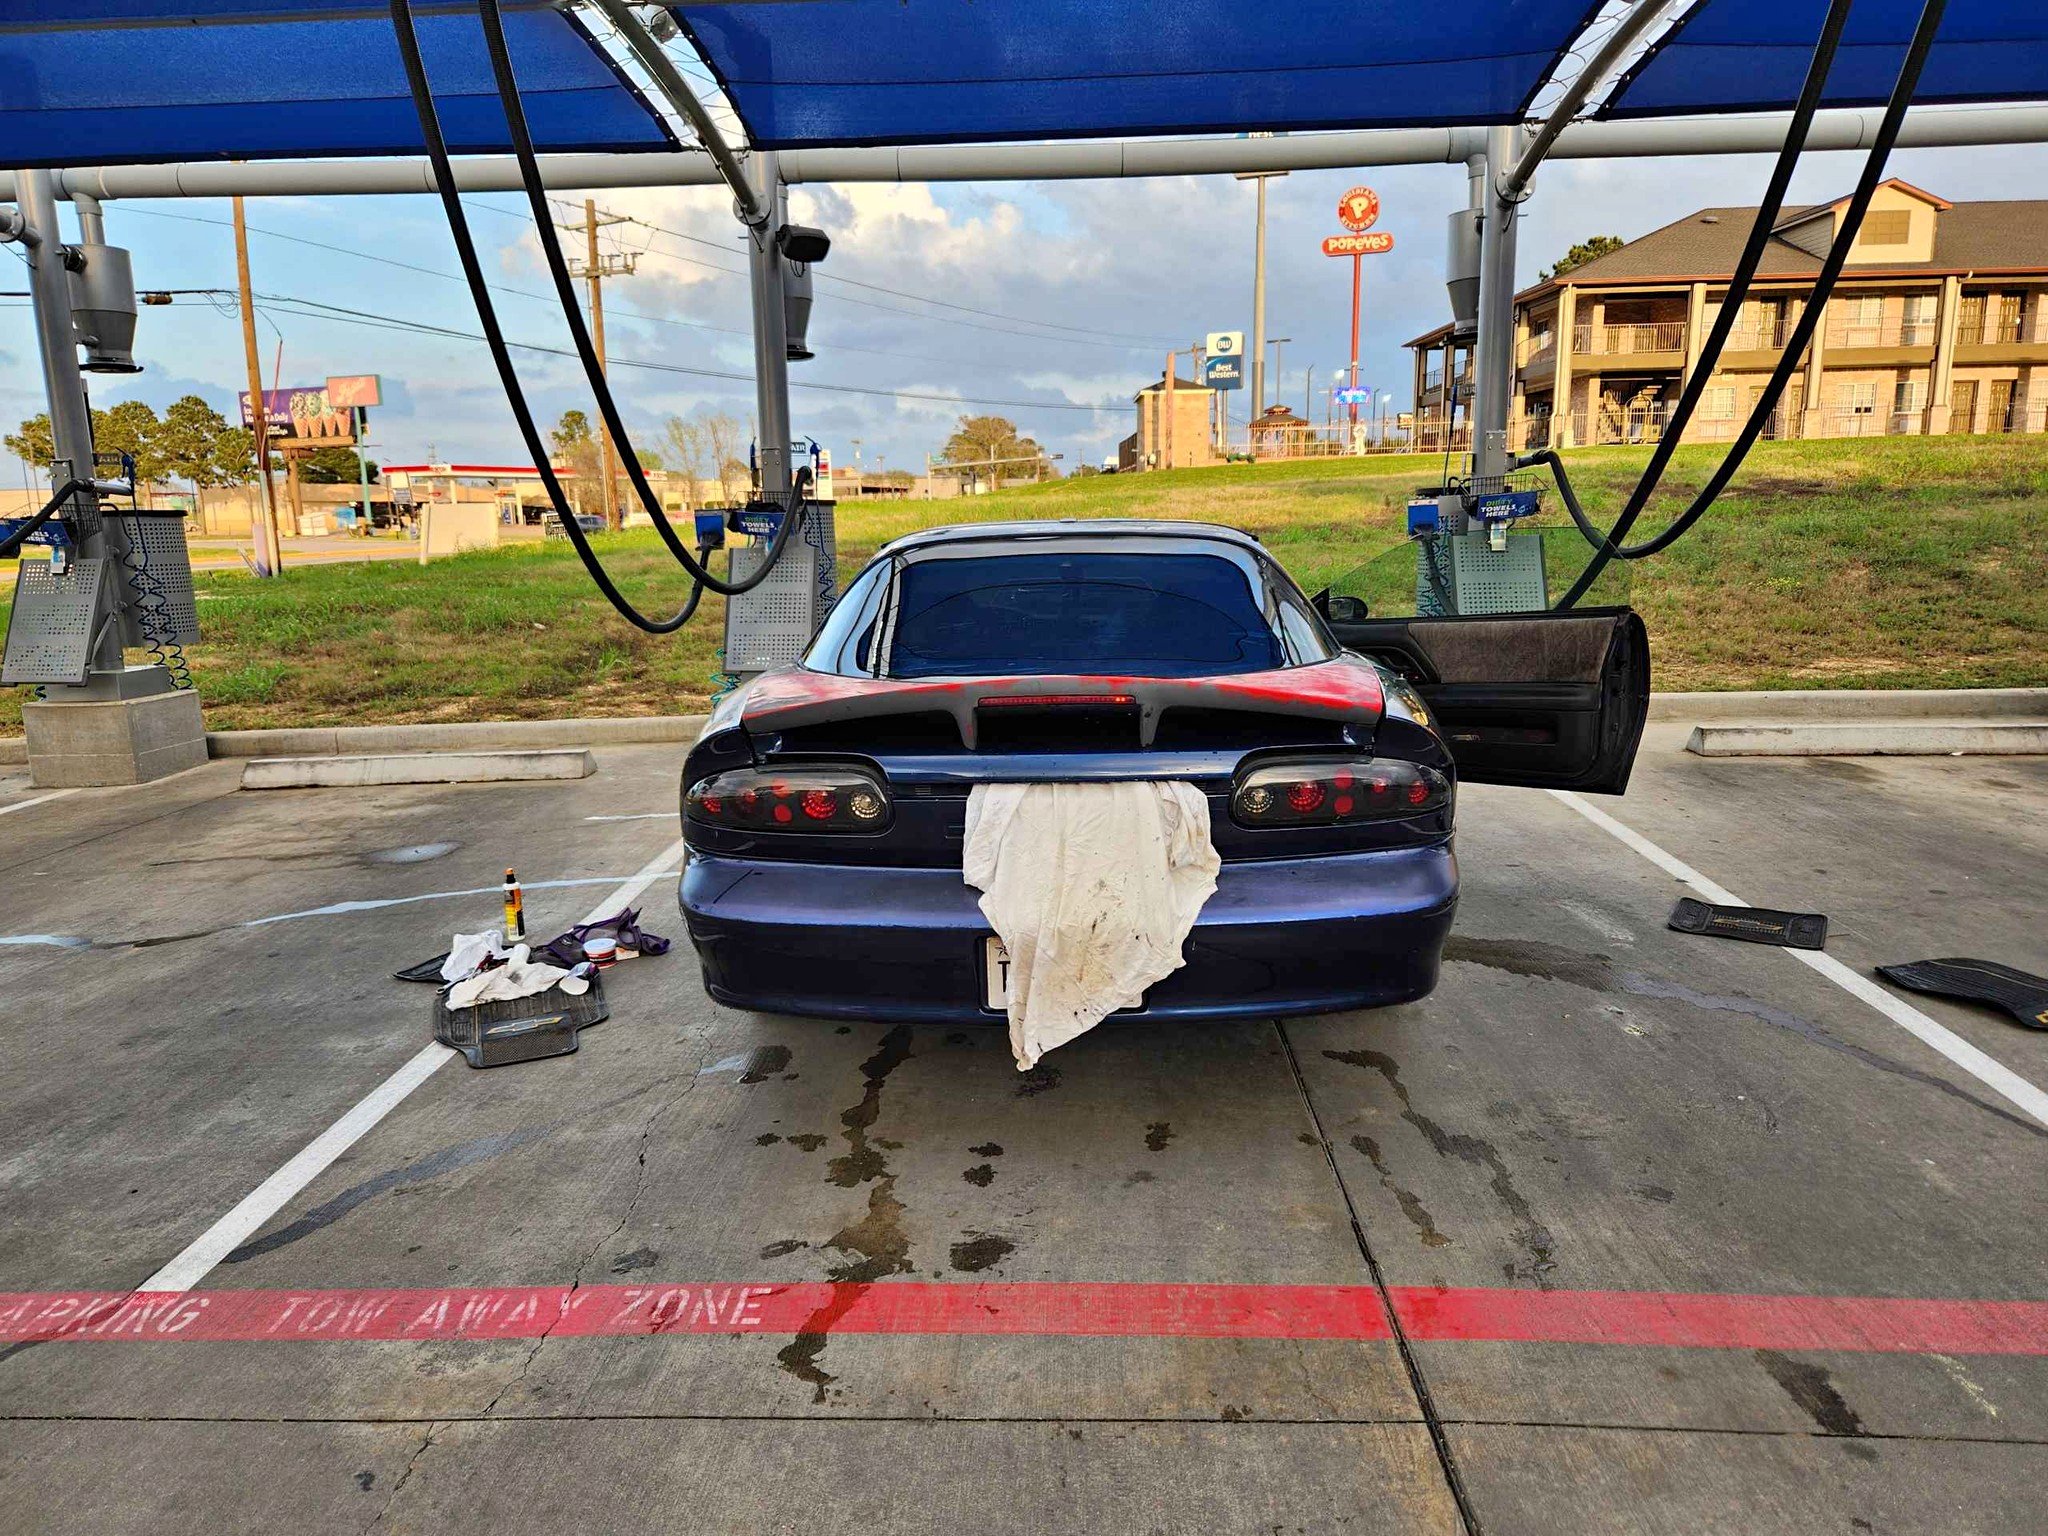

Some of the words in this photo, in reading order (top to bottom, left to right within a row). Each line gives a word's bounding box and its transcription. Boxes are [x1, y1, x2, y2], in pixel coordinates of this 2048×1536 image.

[1328, 234, 1388, 251] POPEYES
[1486, 498, 1512, 506] DIRTY
[267, 1296, 397, 1334] TOW
[404, 1293, 590, 1334] AWAY
[611, 1286, 772, 1327] ZONE
